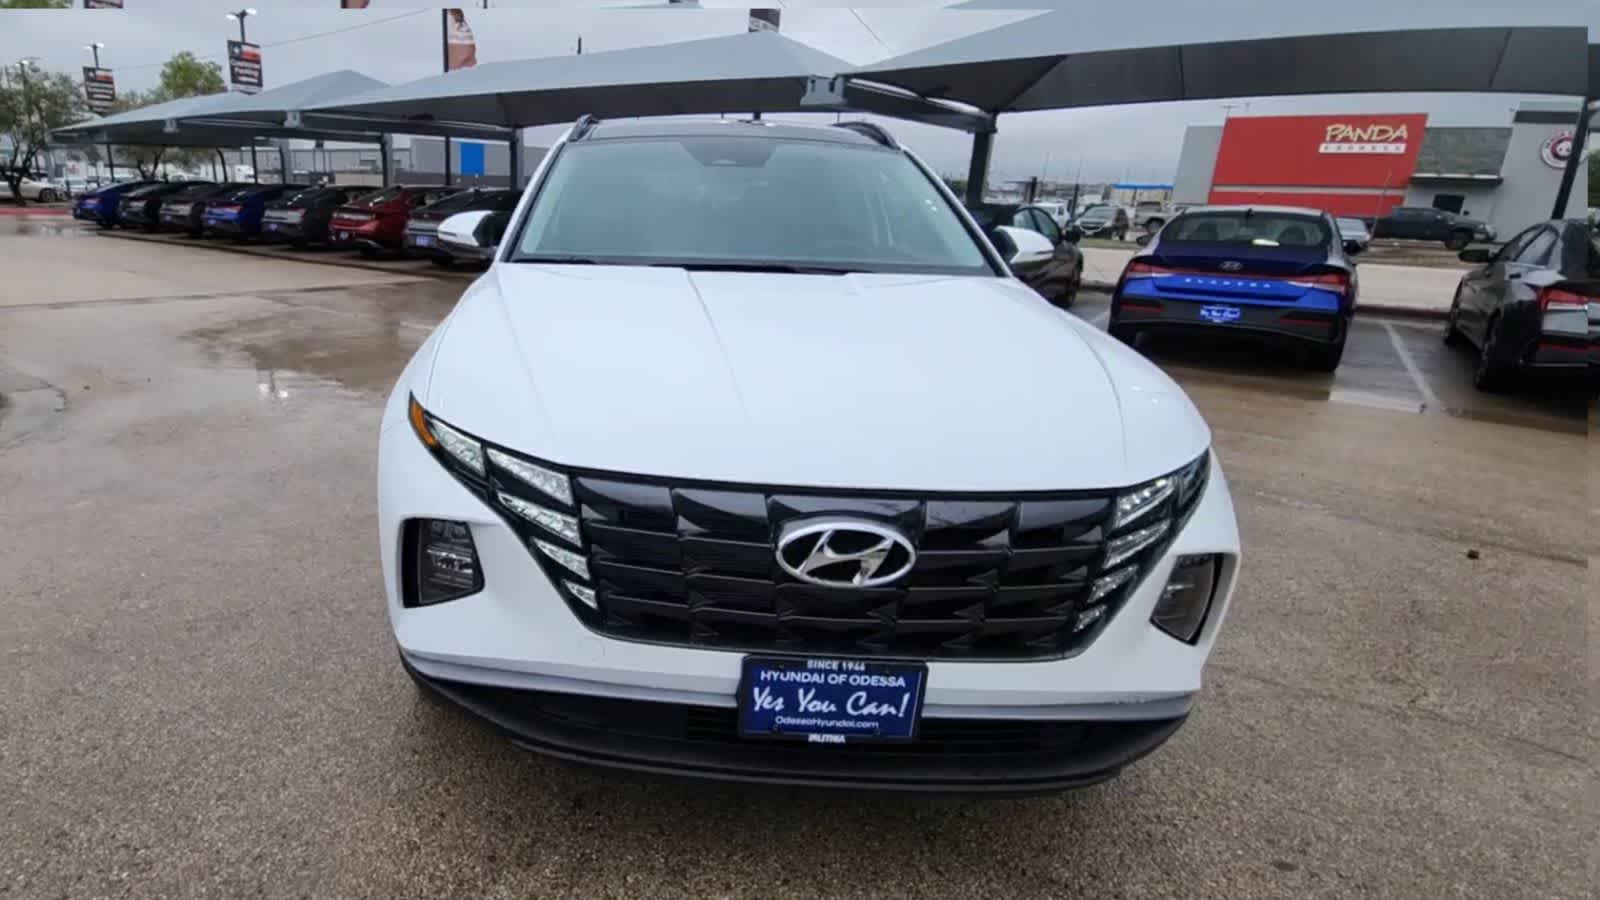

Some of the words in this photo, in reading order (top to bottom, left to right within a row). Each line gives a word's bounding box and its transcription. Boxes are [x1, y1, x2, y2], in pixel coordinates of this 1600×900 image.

[1326, 124, 1408, 141] PANDA
[807, 659, 839, 671] SINCE
[760, 670, 825, 684] HYUNDAI
[827, 673, 847, 685] OF
[849, 674, 906, 687] ODESSA
[753, 686, 784, 711] Yes
[797, 687, 837, 712] You
[846, 690, 910, 717] Can!
[775, 716, 880, 728] OdessaHyundai.com
